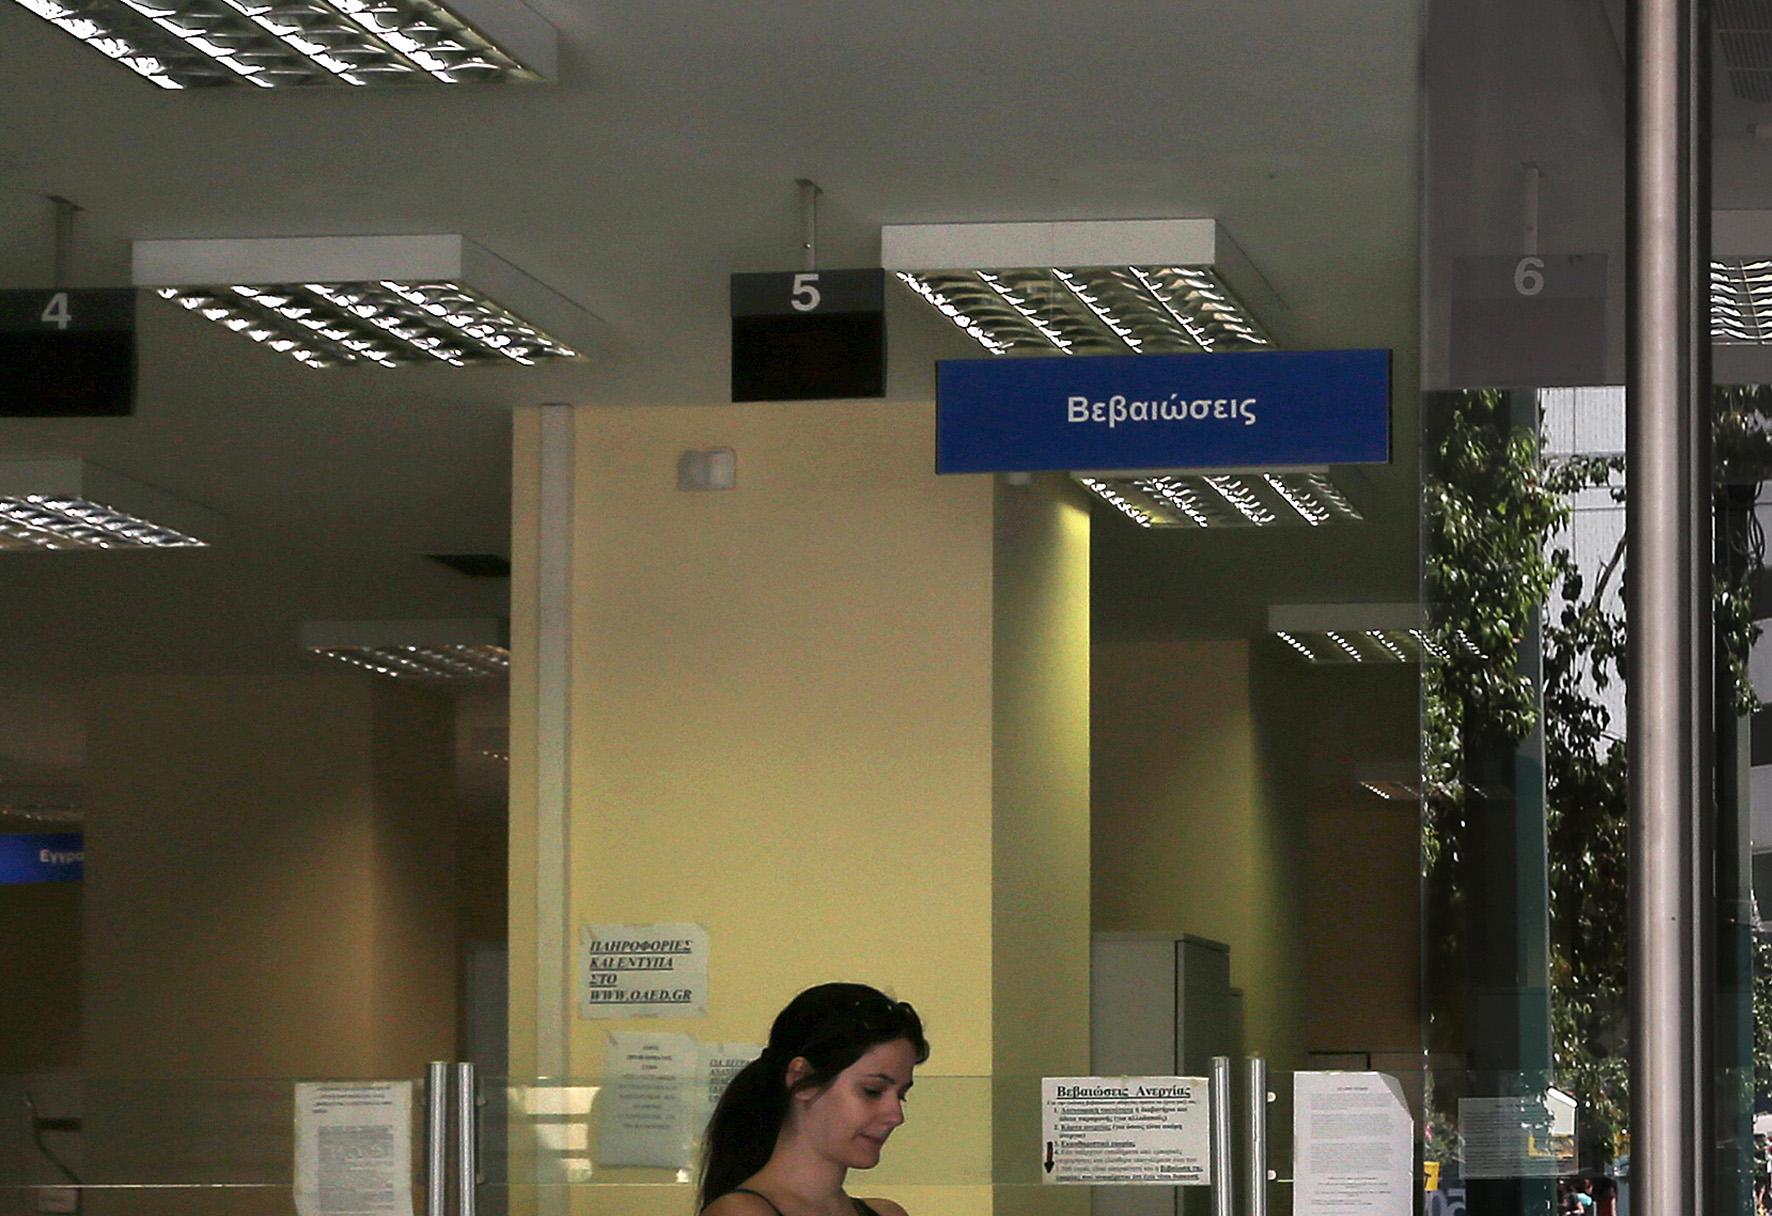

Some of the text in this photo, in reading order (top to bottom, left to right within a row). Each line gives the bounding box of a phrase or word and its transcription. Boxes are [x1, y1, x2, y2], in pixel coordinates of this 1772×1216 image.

[1513, 256, 1545, 297] 6
[790, 273, 822, 313] 5
[40, 293, 73, 332] 4
[1066, 393, 1258, 426] Βεβαιώσεις
[589, 940, 693, 953] ΠΛΗΡΟΦΟΡΙΕΣ
[589, 956, 674, 969] ΚΑΙ ΕΝΤΥΠΑ
[589, 973, 618, 986] ΣΤΟ
[589, 989, 692, 1002] WWW.OAED.GR
[1056, 1085, 1191, 1099] Βεβαιώσεις Ανεργίας
